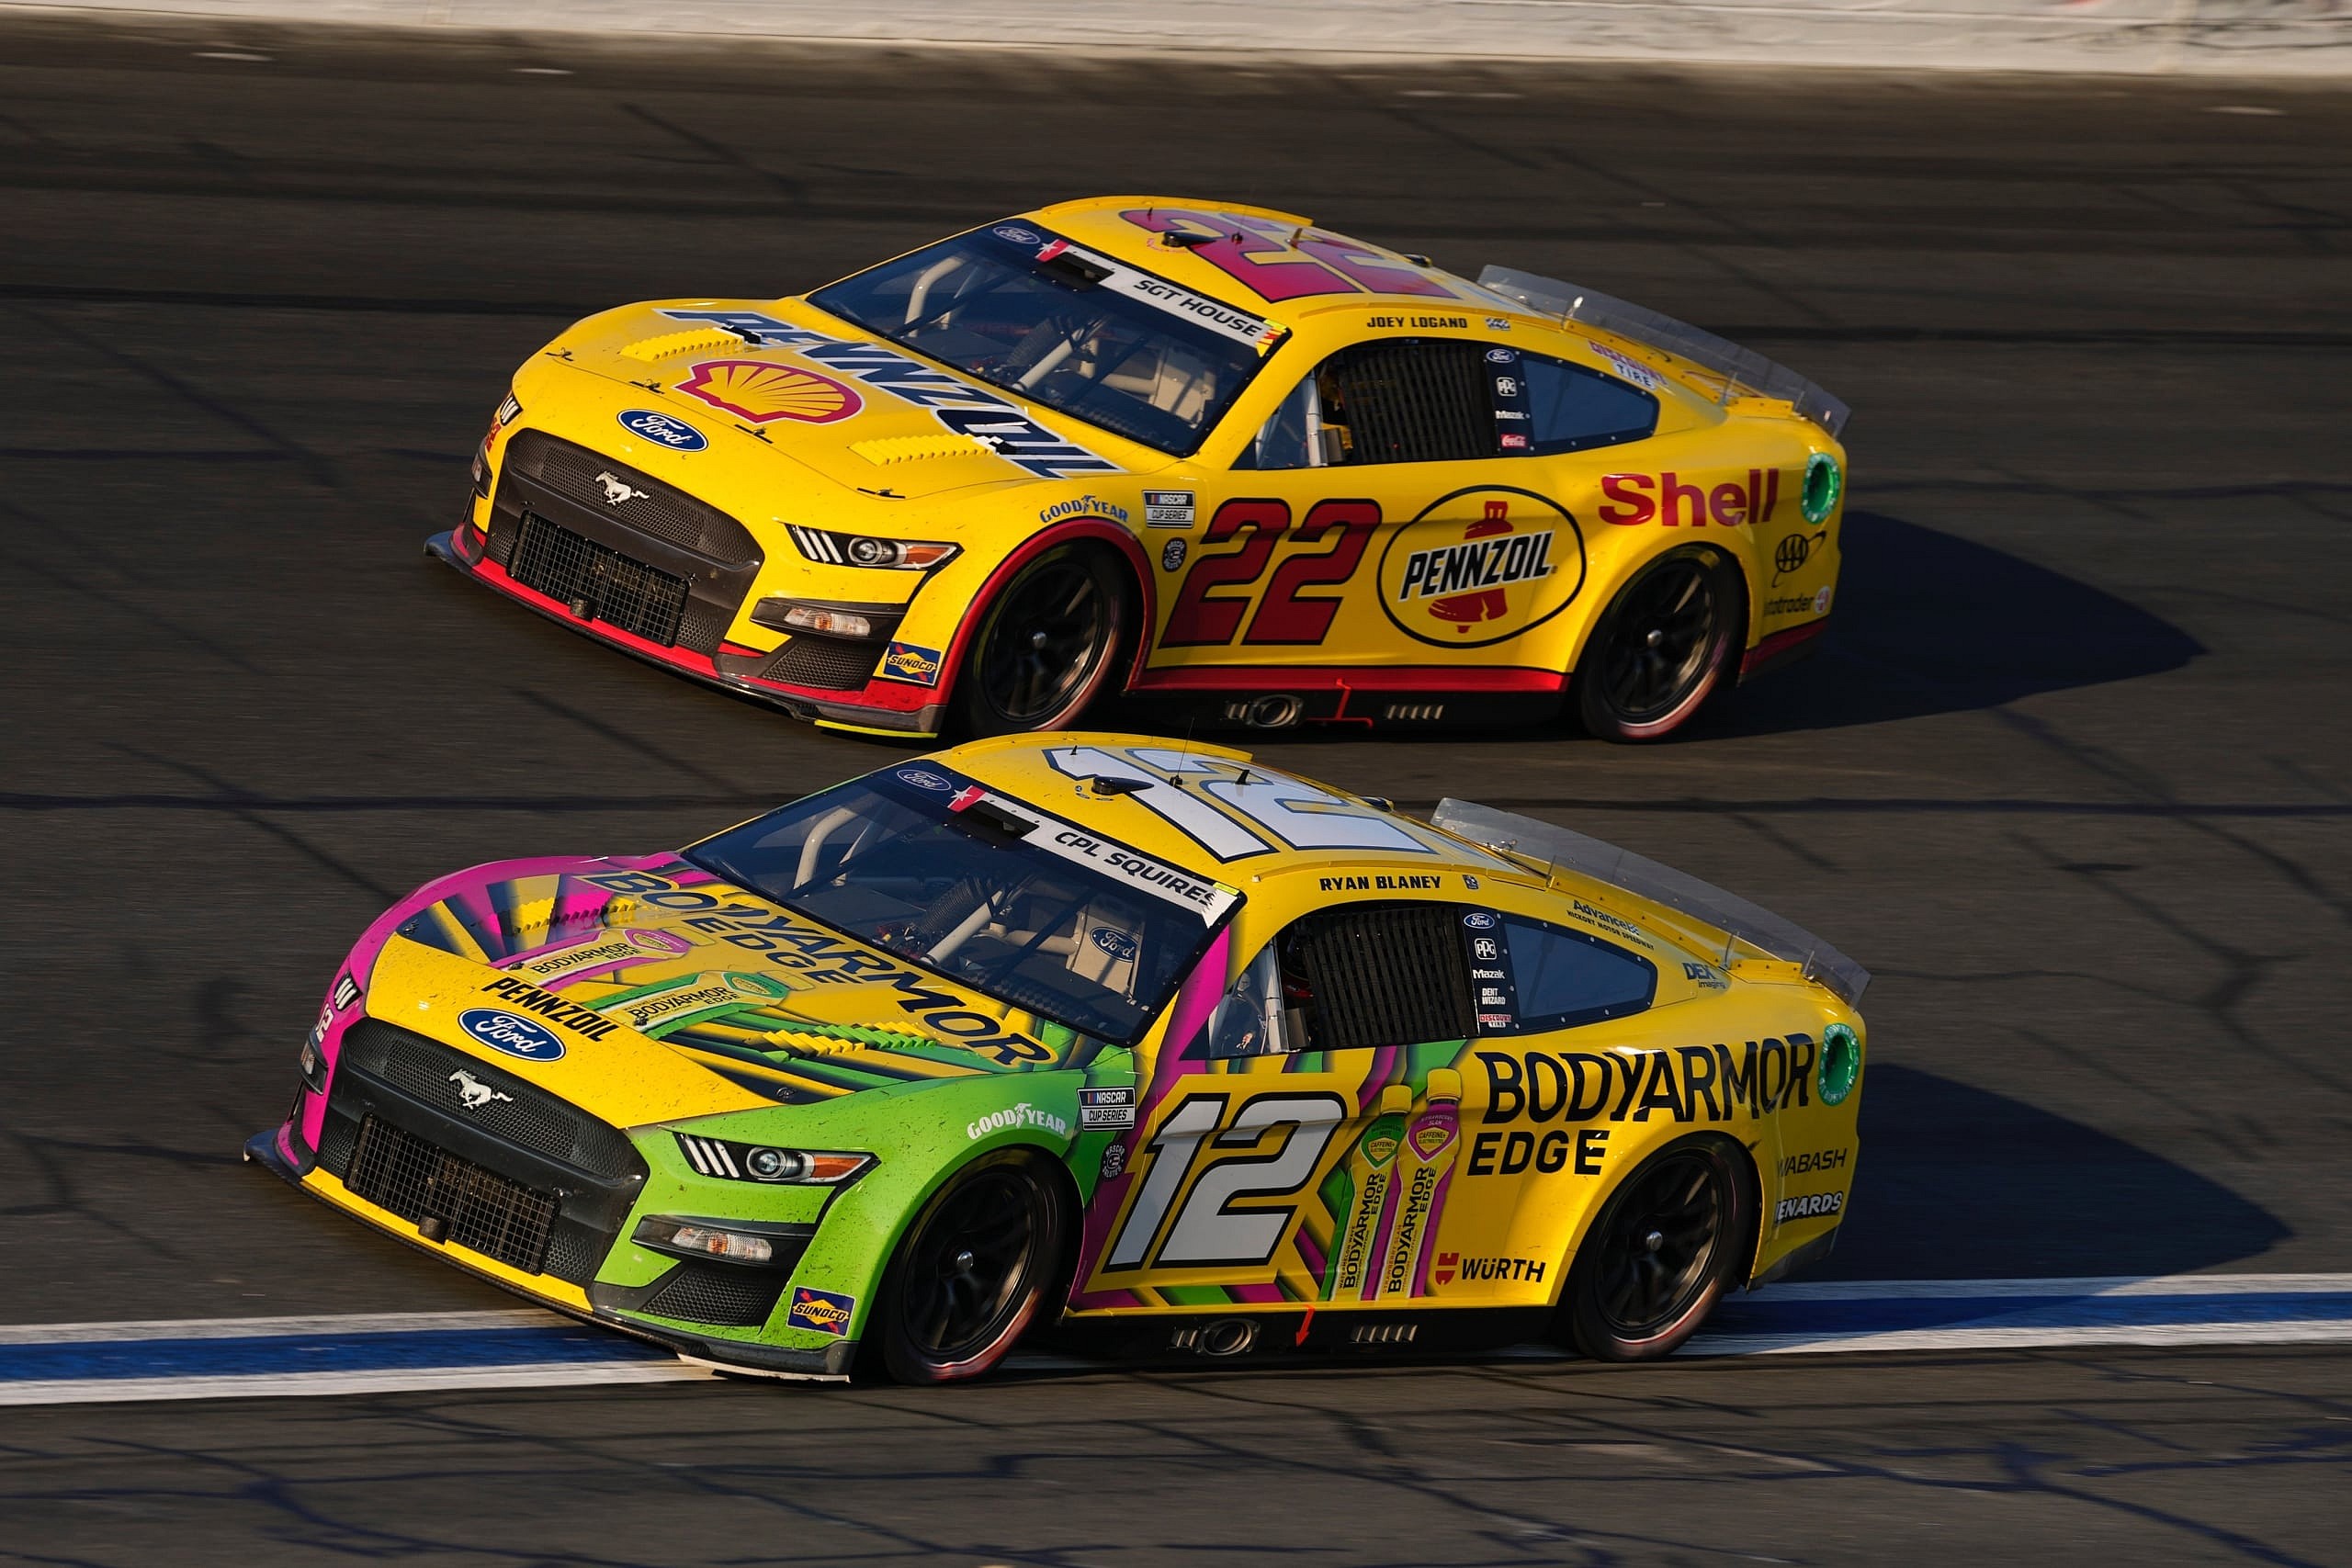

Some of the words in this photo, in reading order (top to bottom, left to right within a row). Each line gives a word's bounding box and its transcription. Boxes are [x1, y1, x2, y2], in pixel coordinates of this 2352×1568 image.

[1002, 229, 1035, 243] Ford
[1134, 279, 1182, 301] SGT
[1179, 298, 1263, 337] HOUSE
[1367, 317, 1405, 328] JOEY
[1411, 317, 1468, 329] LOGANO
[1616, 363, 1654, 388] TIRE
[652, 309, 1126, 479] PENNZOIL
[630, 414, 693, 445] Ford
[1039, 494, 1129, 524] GOODYEAR
[1160, 494, 1188, 505] NASCAR
[1598, 468, 1780, 527] Shell
[1151, 510, 1165, 520] CUP
[1165, 510, 1188, 521] SERIES
[1159, 498, 1383, 649] 22
[1398, 530, 1555, 603] PENNZOIL
[889, 656, 934, 671] SUNOCO
[910, 771, 944, 790] Ford
[1042, 747, 1440, 863] 12
[1054, 831, 1098, 858] CPL
[1103, 850, 1217, 907] SQUIRES
[1319, 876, 1370, 891] RYAN
[1375, 875, 1441, 889] BLANEY
[1573, 899, 1630, 931] Advance
[529, 942, 634, 975] BODYARMOR
[605, 949, 641, 961] EDGE
[680, 918, 864, 984] EDGE
[1098, 928, 1136, 960] Ford
[1477, 941, 1497, 958] PPG
[1473, 969, 1506, 979] Mazak
[1681, 963, 1717, 980] DEX
[628, 986, 733, 1020] BODYARMOR
[704, 992, 741, 1005] EDGE
[1482, 987, 1498, 997] DENT
[1482, 997, 1506, 1006] WIZARD
[315, 1002, 334, 1043] 12
[481, 976, 619, 1043] PENNZOIL
[1479, 1014, 1511, 1023] DISCOUNT
[475, 1014, 548, 1053] Ford
[1474, 1032, 1816, 1125] BODYARMOR
[1096, 1091, 1126, 1104] NASCAR
[967, 1102, 1067, 1140] GOODYEAR
[1089, 1111, 1102, 1122] CUP
[1102, 1110, 1127, 1122] SERIES
[1467, 1129, 1611, 1176] EDGE
[1777, 1147, 1848, 1177] WABASH
[1101, 1090, 1349, 1274] 12
[1371, 1173, 1386, 1215] EDGE
[1419, 1168, 1437, 1213] EDGE
[1775, 1192, 1842, 1222] ENARDS
[1343, 1173, 1381, 1290] BODYARMOR
[1387, 1167, 1430, 1294] BODYARMOR
[1462, 1258, 1546, 1283] WÜRTH
[795, 1303, 847, 1321] SUNOCO
